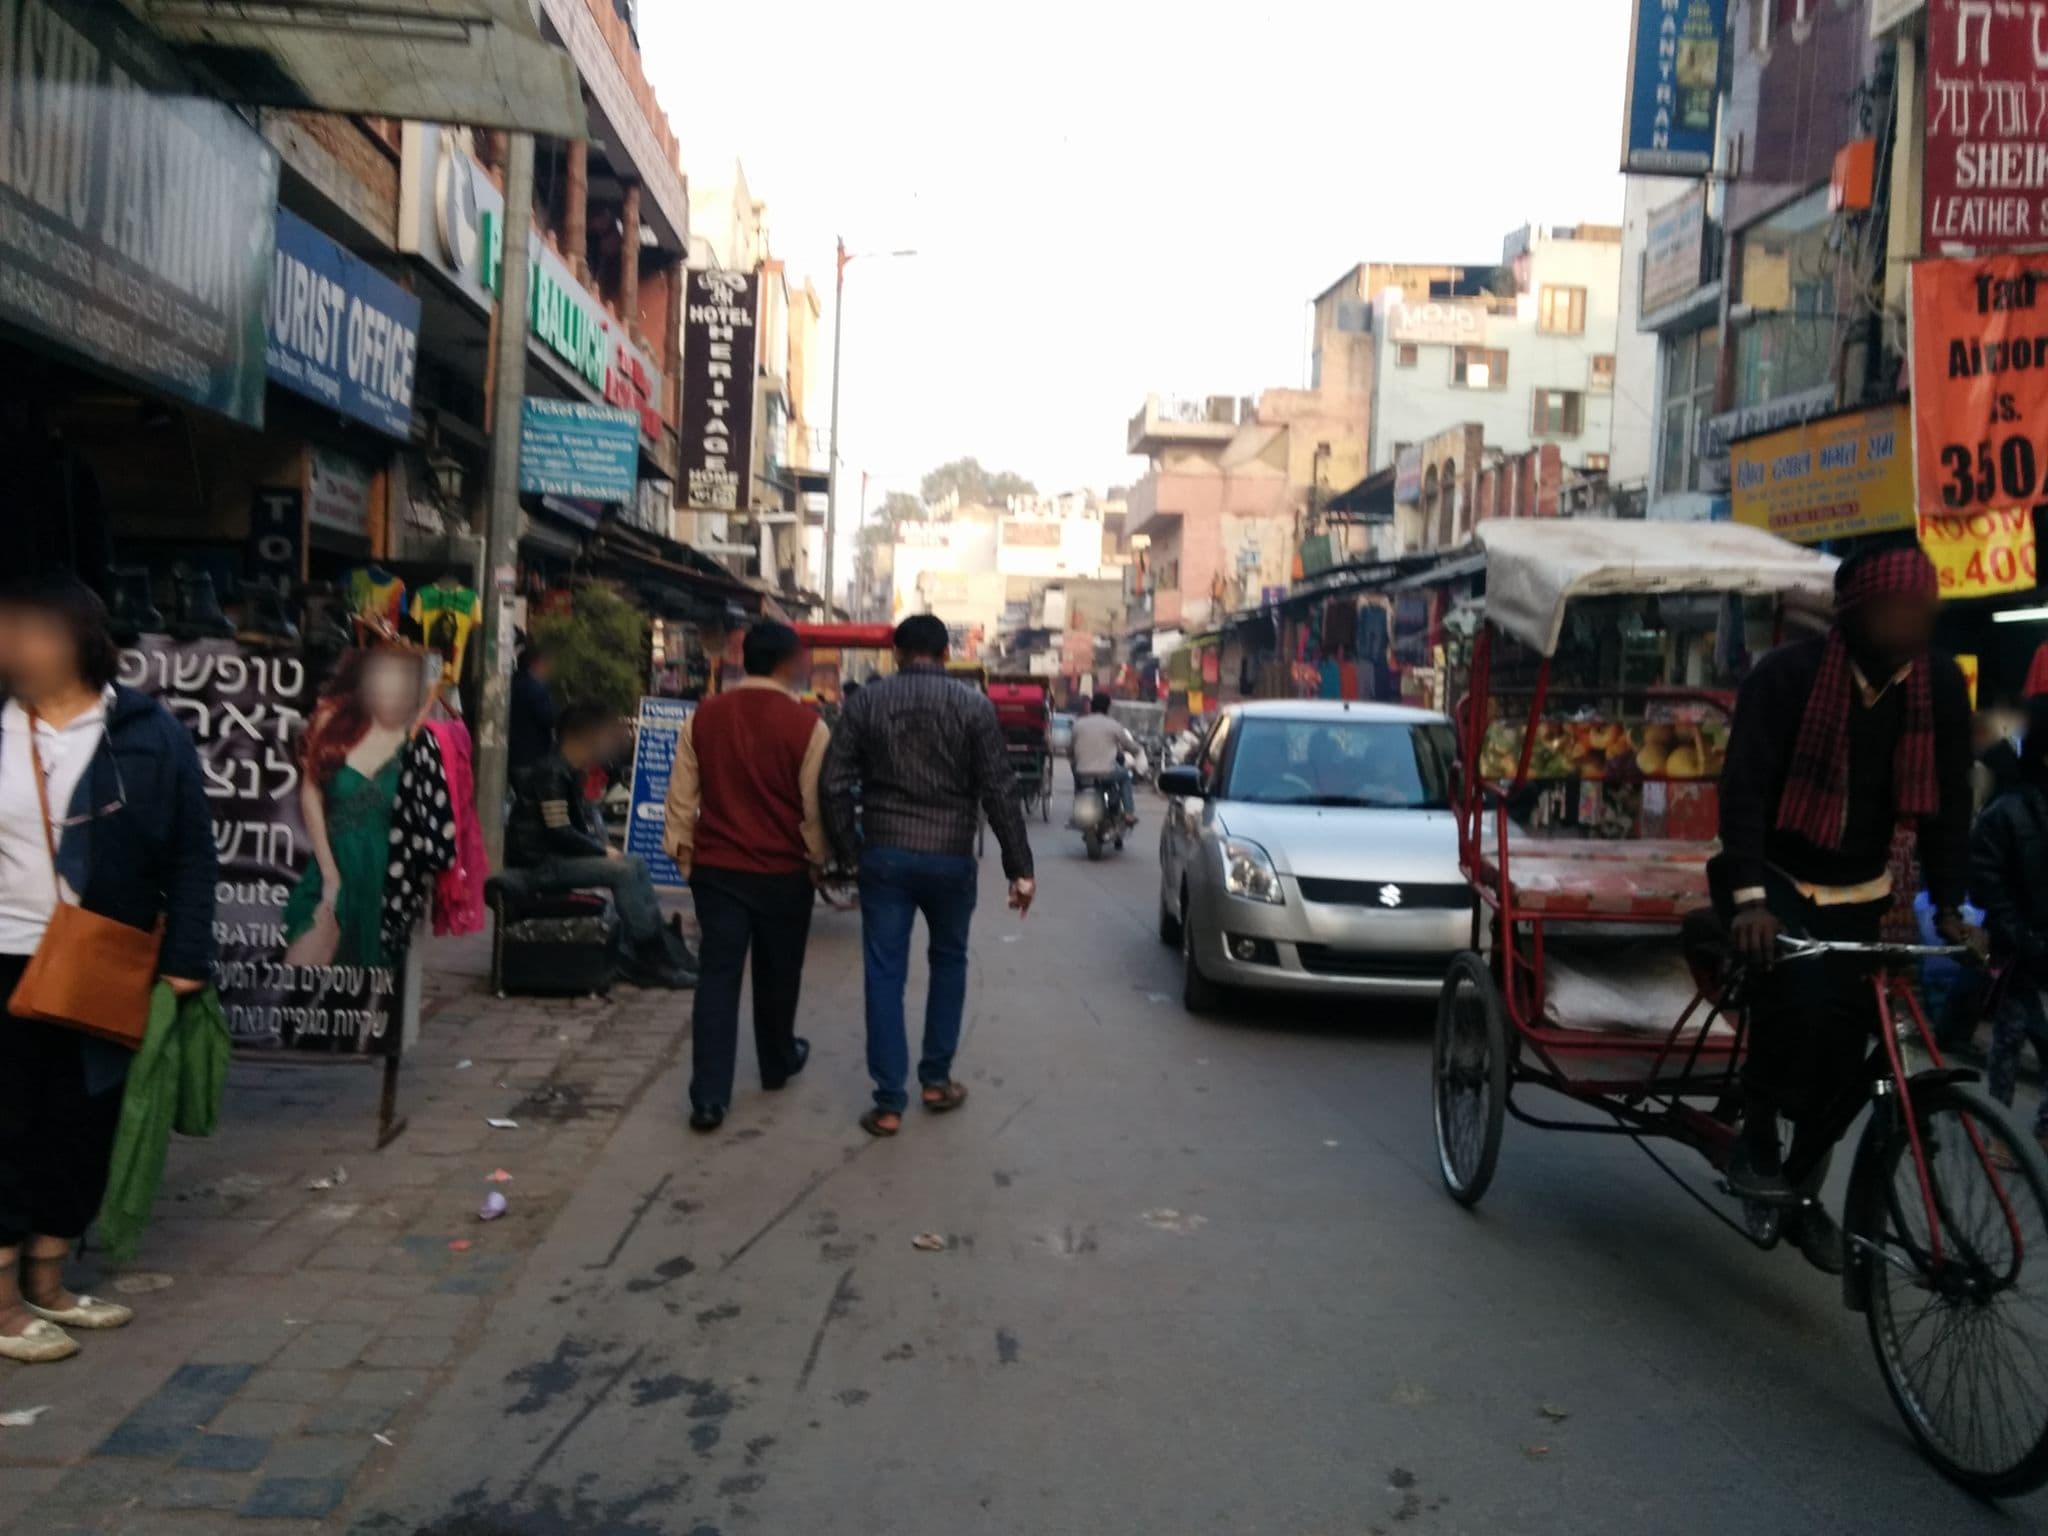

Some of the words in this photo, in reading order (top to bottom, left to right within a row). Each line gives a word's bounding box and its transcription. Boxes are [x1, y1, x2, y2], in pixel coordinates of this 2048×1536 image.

[1931, 197, 2030, 237] LEATHER
[347, 296, 416, 409] OFFICE
[689, 303, 753, 327] HOTEL
[702, 325, 735, 473] HERITAGE
